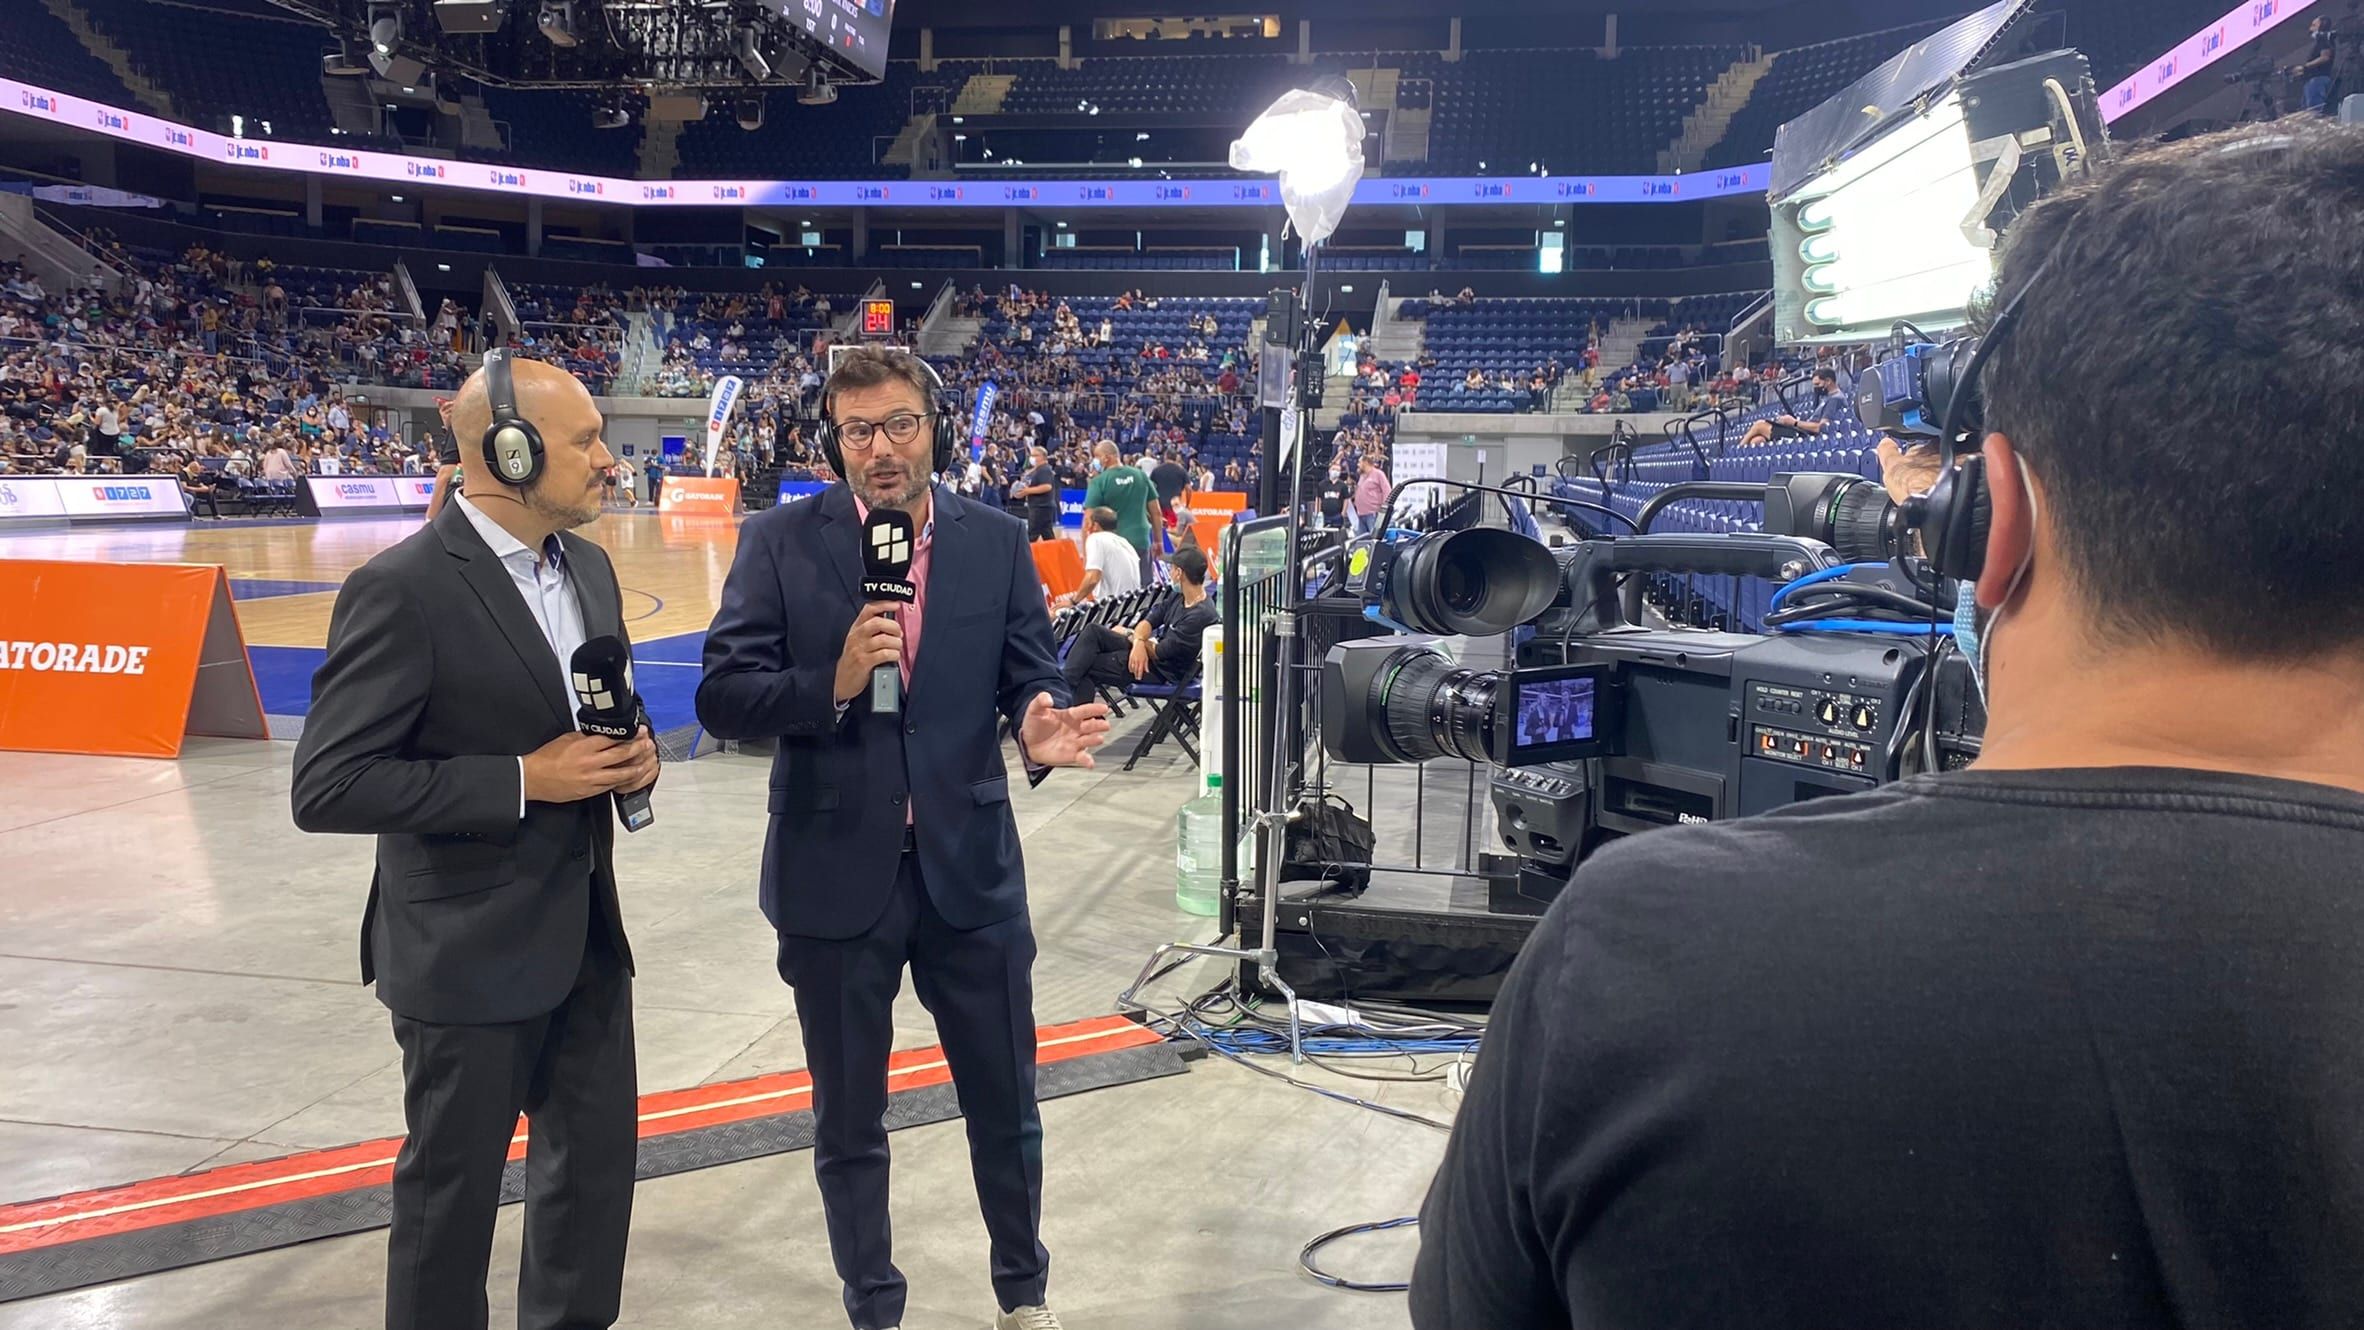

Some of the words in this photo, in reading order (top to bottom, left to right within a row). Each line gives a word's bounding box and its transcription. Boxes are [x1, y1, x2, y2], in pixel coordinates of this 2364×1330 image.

[870, 303, 891, 314] 8:00
[868, 314, 888, 331] 24
[975, 386, 993, 436] casmu
[511, 462, 520, 473] 9
[1115, 476, 1134, 486] Staff
[341, 484, 375, 494] casmu
[1191, 509, 1233, 517] GATORADE
[864, 582, 878, 593] TV
[880, 582, 913, 596] CIUDAD
[579, 722, 590, 732] TV
[591, 724, 627, 737] CIUDAD
